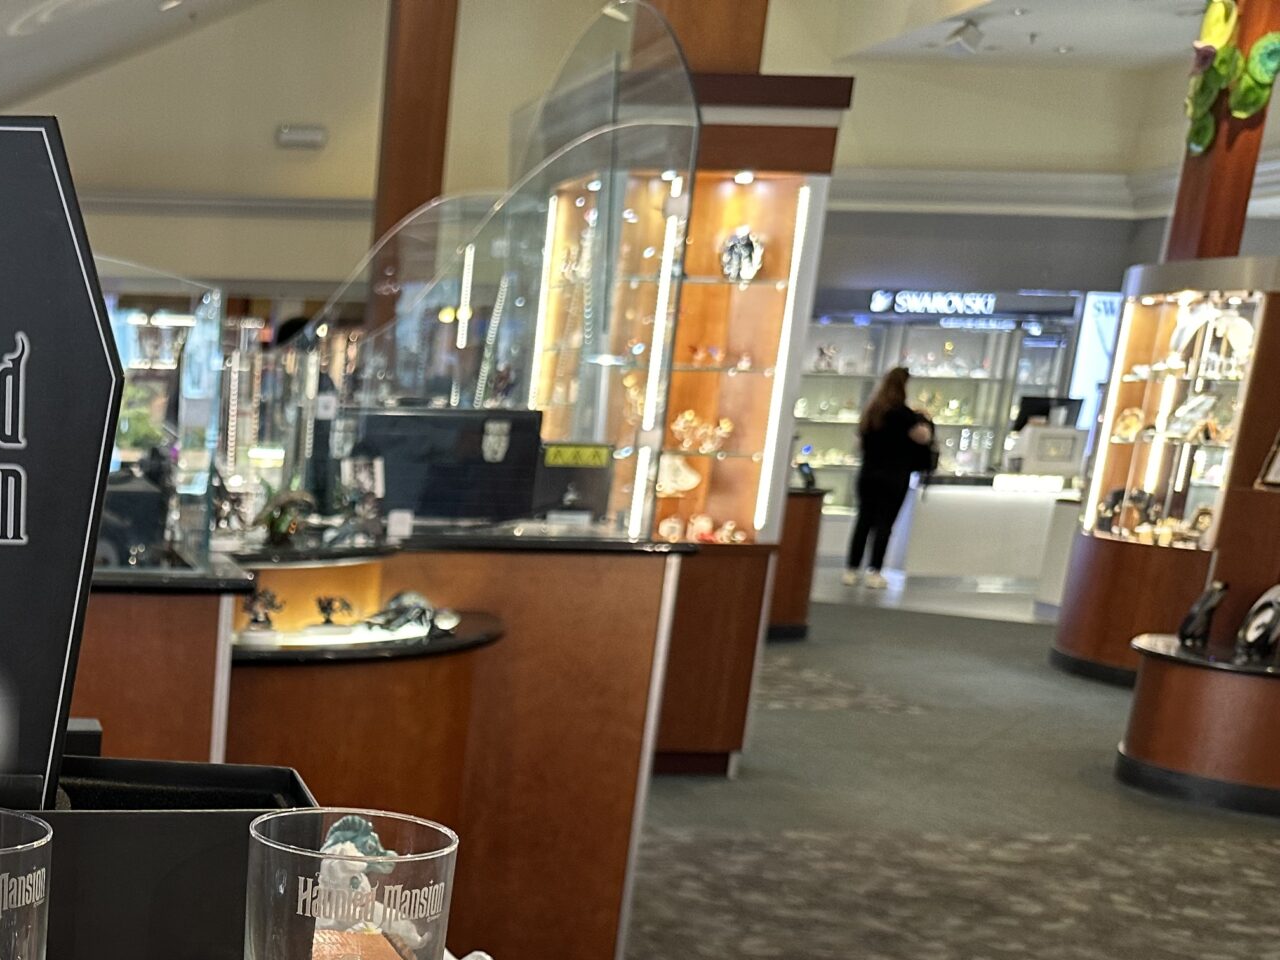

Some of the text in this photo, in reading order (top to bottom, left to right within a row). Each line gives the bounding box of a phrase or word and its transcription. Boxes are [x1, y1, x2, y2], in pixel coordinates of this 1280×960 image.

[894, 290, 996, 314] SWAROVSKI
[296, 876, 445, 929] Haunted Mansion
